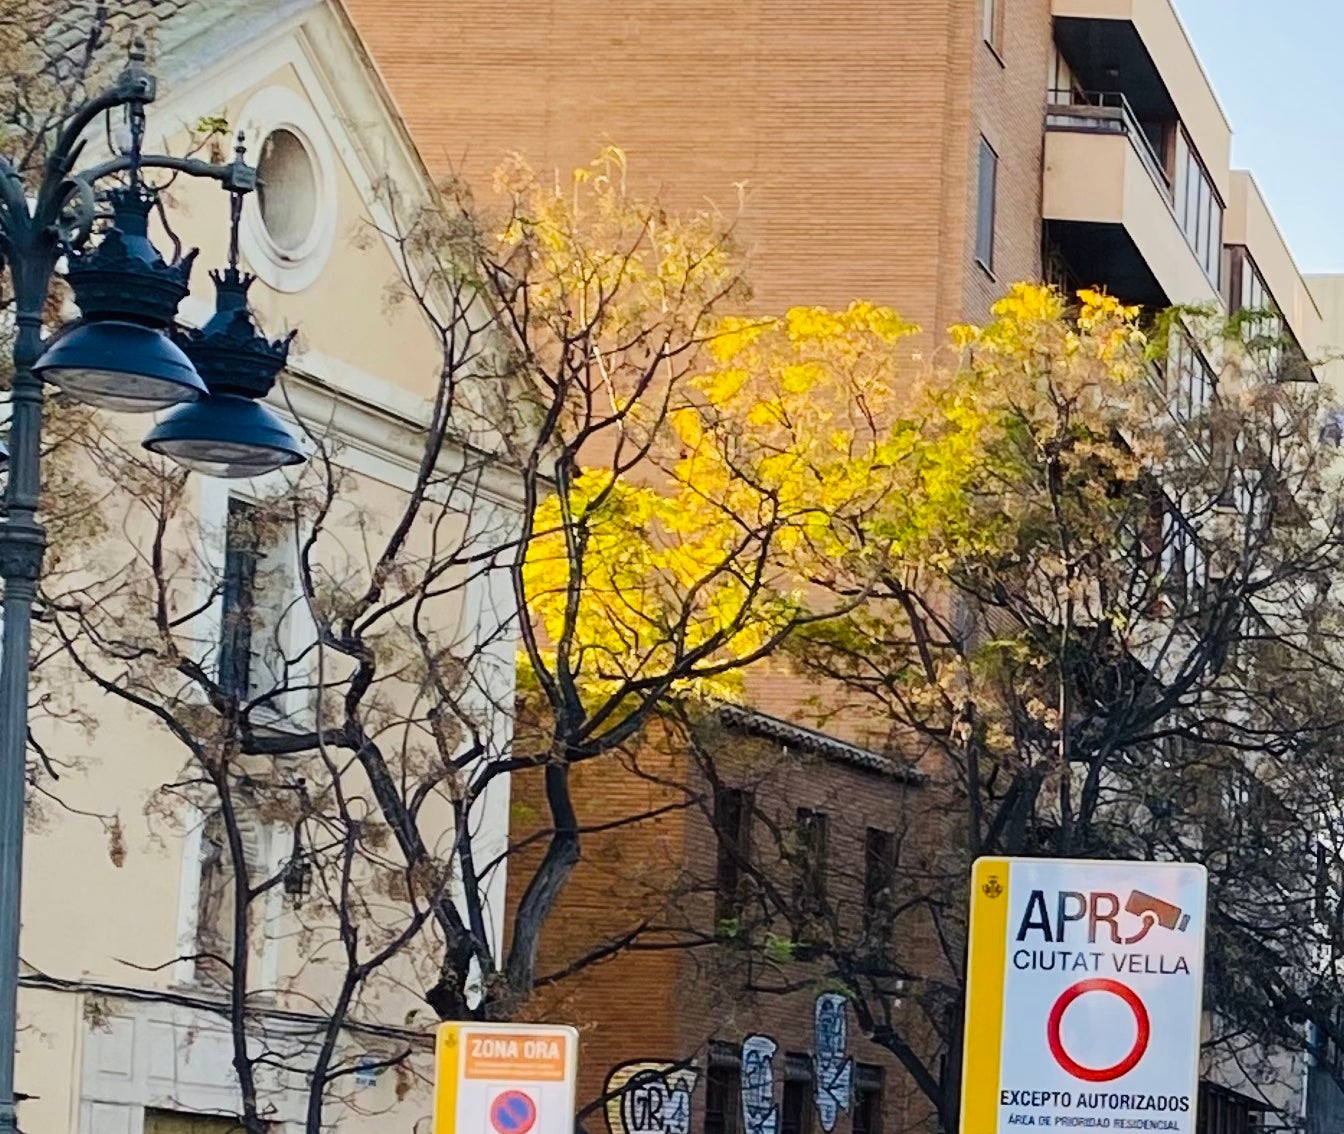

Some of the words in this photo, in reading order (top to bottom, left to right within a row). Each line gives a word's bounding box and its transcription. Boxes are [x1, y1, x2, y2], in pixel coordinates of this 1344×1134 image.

[1016, 890, 1122, 944] APR
[1013, 949, 1105, 972] CIUTAT
[1113, 953, 1190, 975] VELLA
[472, 1039, 518, 1058] ZONA
[524, 1041, 560, 1059] ORA
[1000, 1090, 1072, 1107] EXCEPTO
[1077, 1093, 1190, 1112] AUTORIZADOS
[1039, 1116, 1051, 1126] DE
[1054, 1116, 1110, 1128] PRIORIDAD
[1113, 1118, 1180, 1131] RESIDENCIAL
